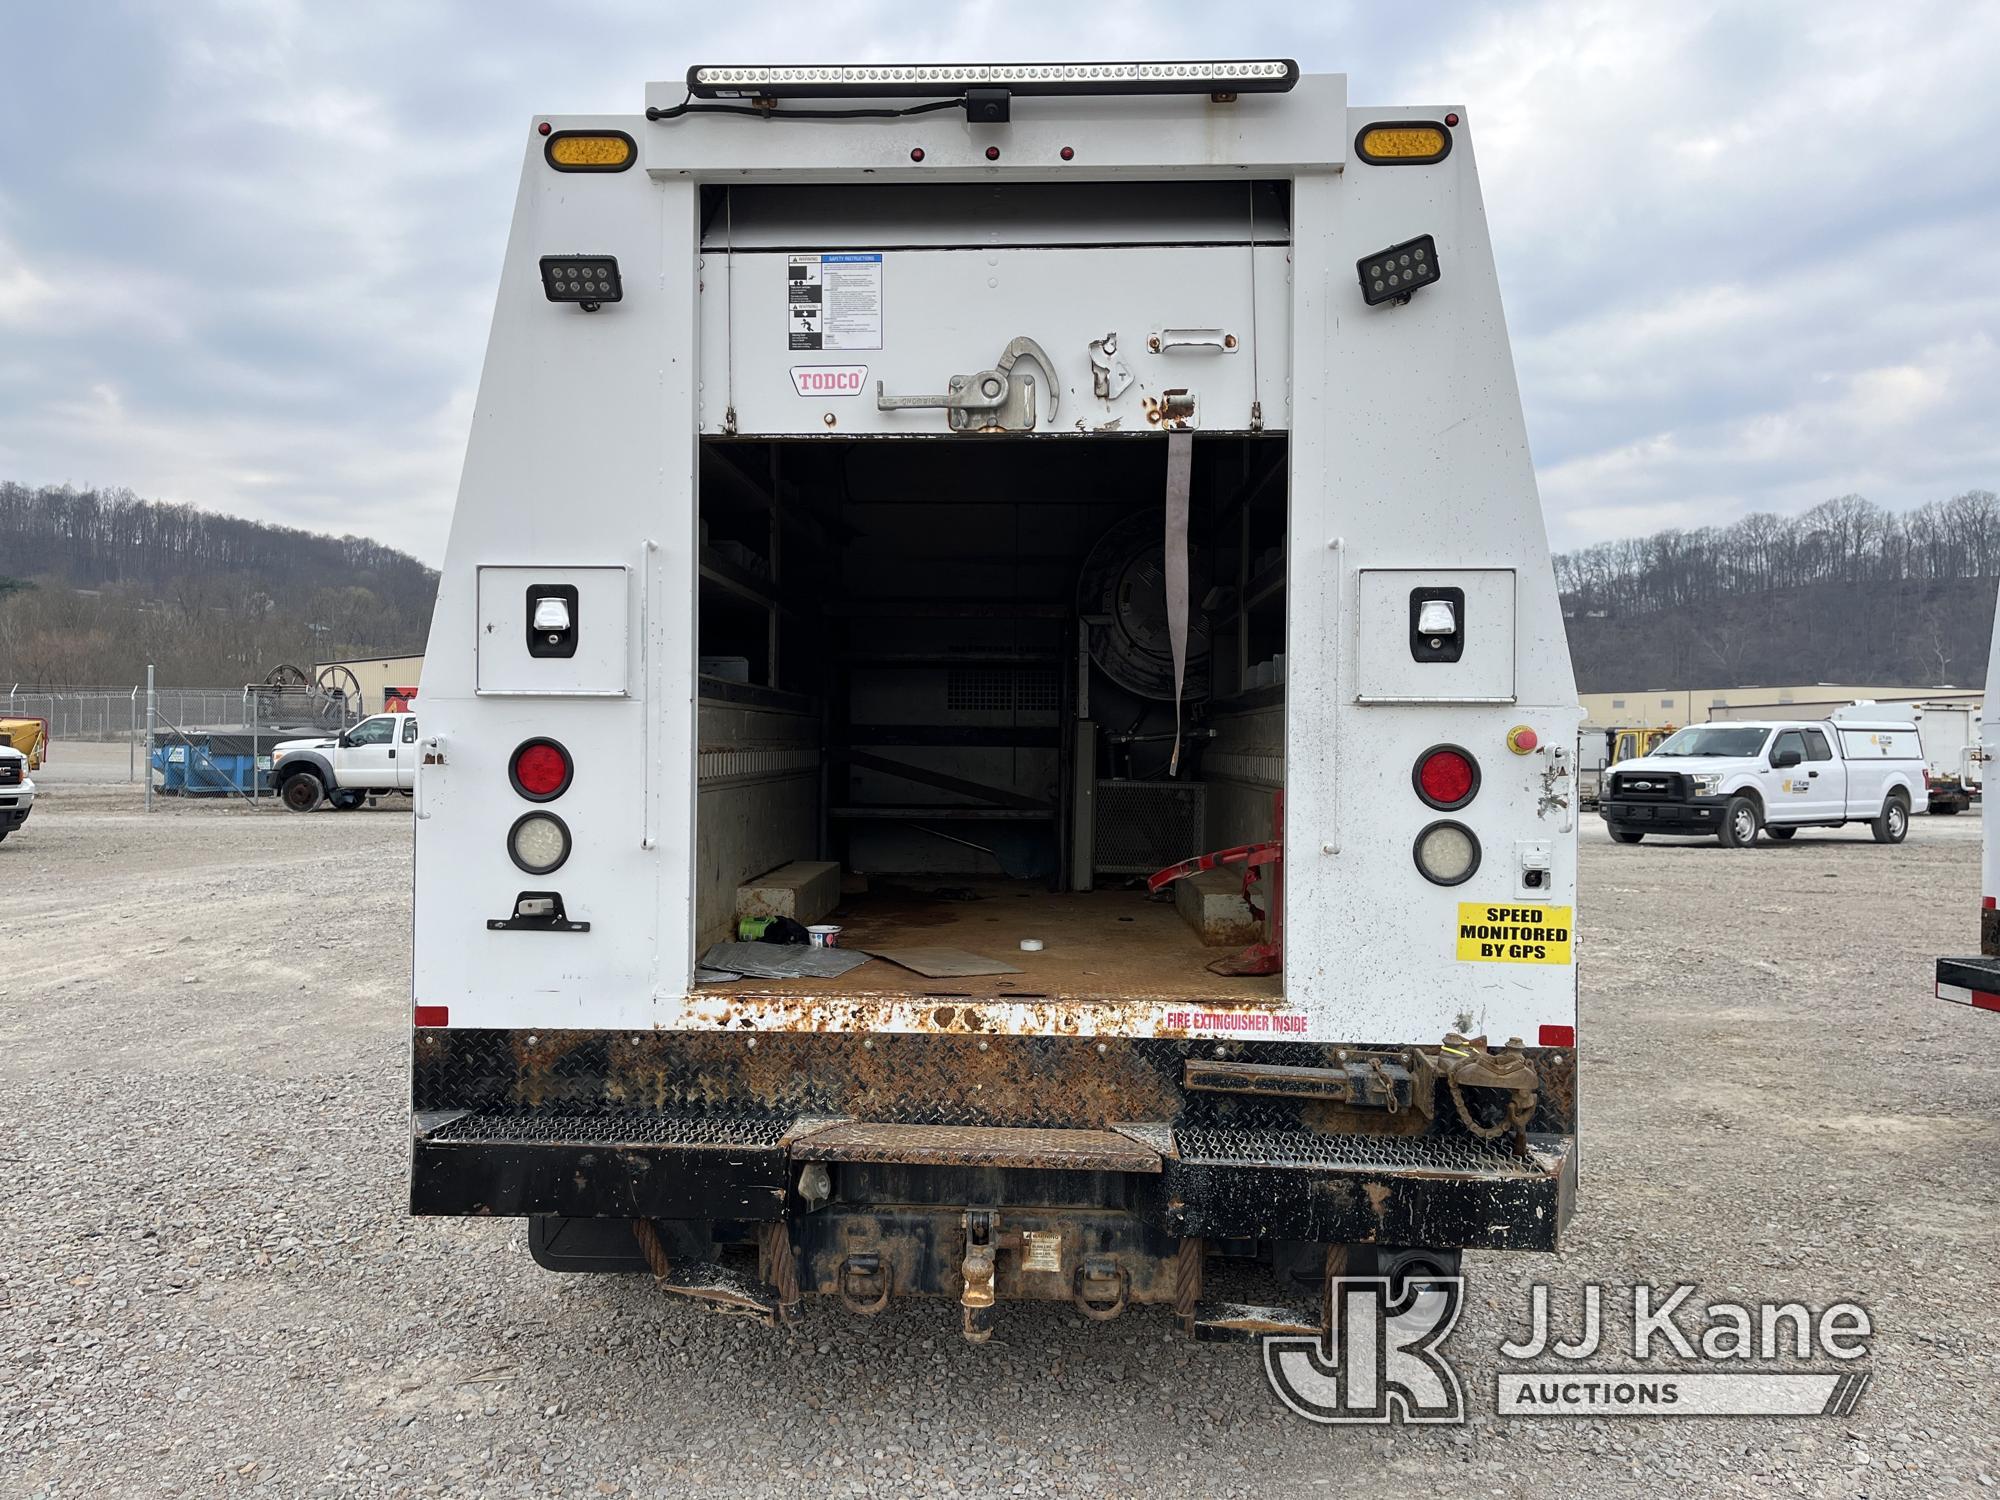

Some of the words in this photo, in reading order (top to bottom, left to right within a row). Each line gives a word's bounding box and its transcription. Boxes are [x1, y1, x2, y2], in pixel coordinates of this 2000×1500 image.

[1487, 908, 1543, 923] SPEED
[1460, 925, 1568, 942] MONITORED
[1481, 943, 1505, 957] BY
[1509, 945, 1546, 959] GPS
[1167, 1012, 1191, 1029] FIRE
[1193, 1012, 1269, 1032] EXTINGUISHER
[1272, 1015, 1308, 1033] INSIDE
